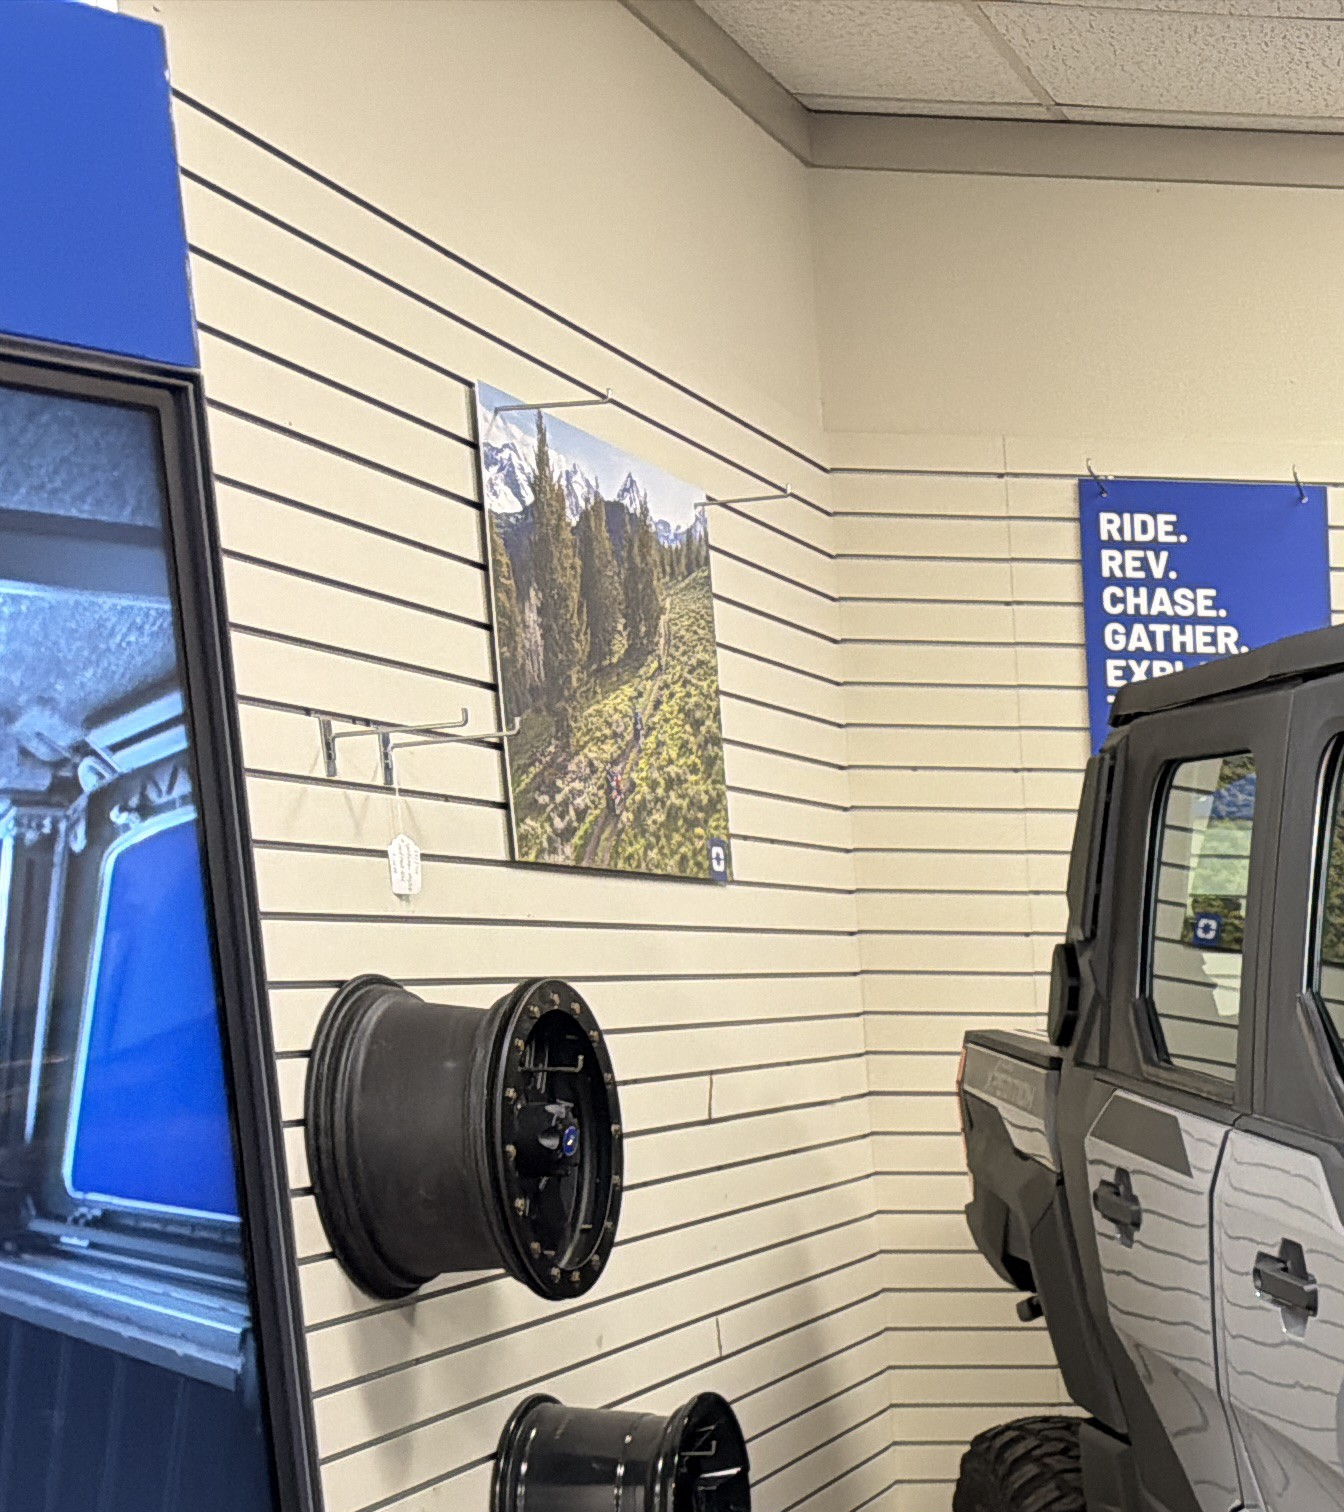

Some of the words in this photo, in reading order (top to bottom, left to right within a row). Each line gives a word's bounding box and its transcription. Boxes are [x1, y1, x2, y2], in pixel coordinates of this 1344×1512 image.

[1099, 512, 1188, 543] RIDE.
[1100, 549, 1178, 580] REV.
[1102, 586, 1227, 618] CHASE.
[1104, 622, 1249, 655] GATHER.
